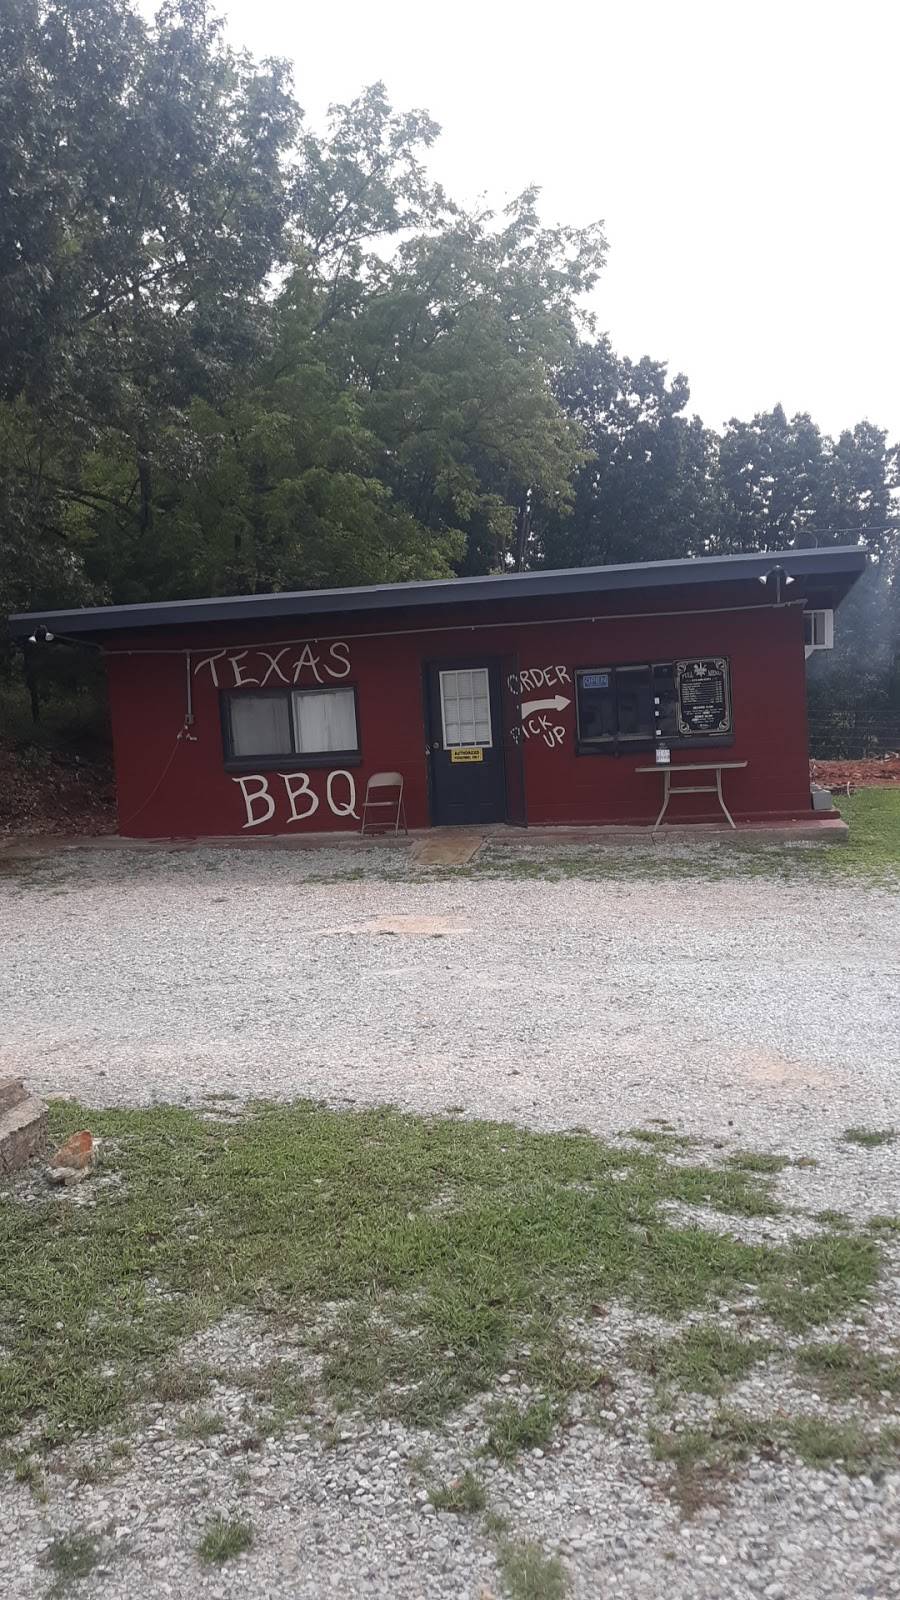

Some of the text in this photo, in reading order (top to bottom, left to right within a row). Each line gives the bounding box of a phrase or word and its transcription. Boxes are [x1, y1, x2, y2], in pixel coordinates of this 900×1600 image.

[194, 642, 350, 687] TEXAS
[507, 665, 572, 695] ORDER
[584, 675, 608, 688] OPEN
[510, 714, 552, 744] PICK
[543, 726, 566, 748] UP
[232, 770, 360, 828] BBQ
